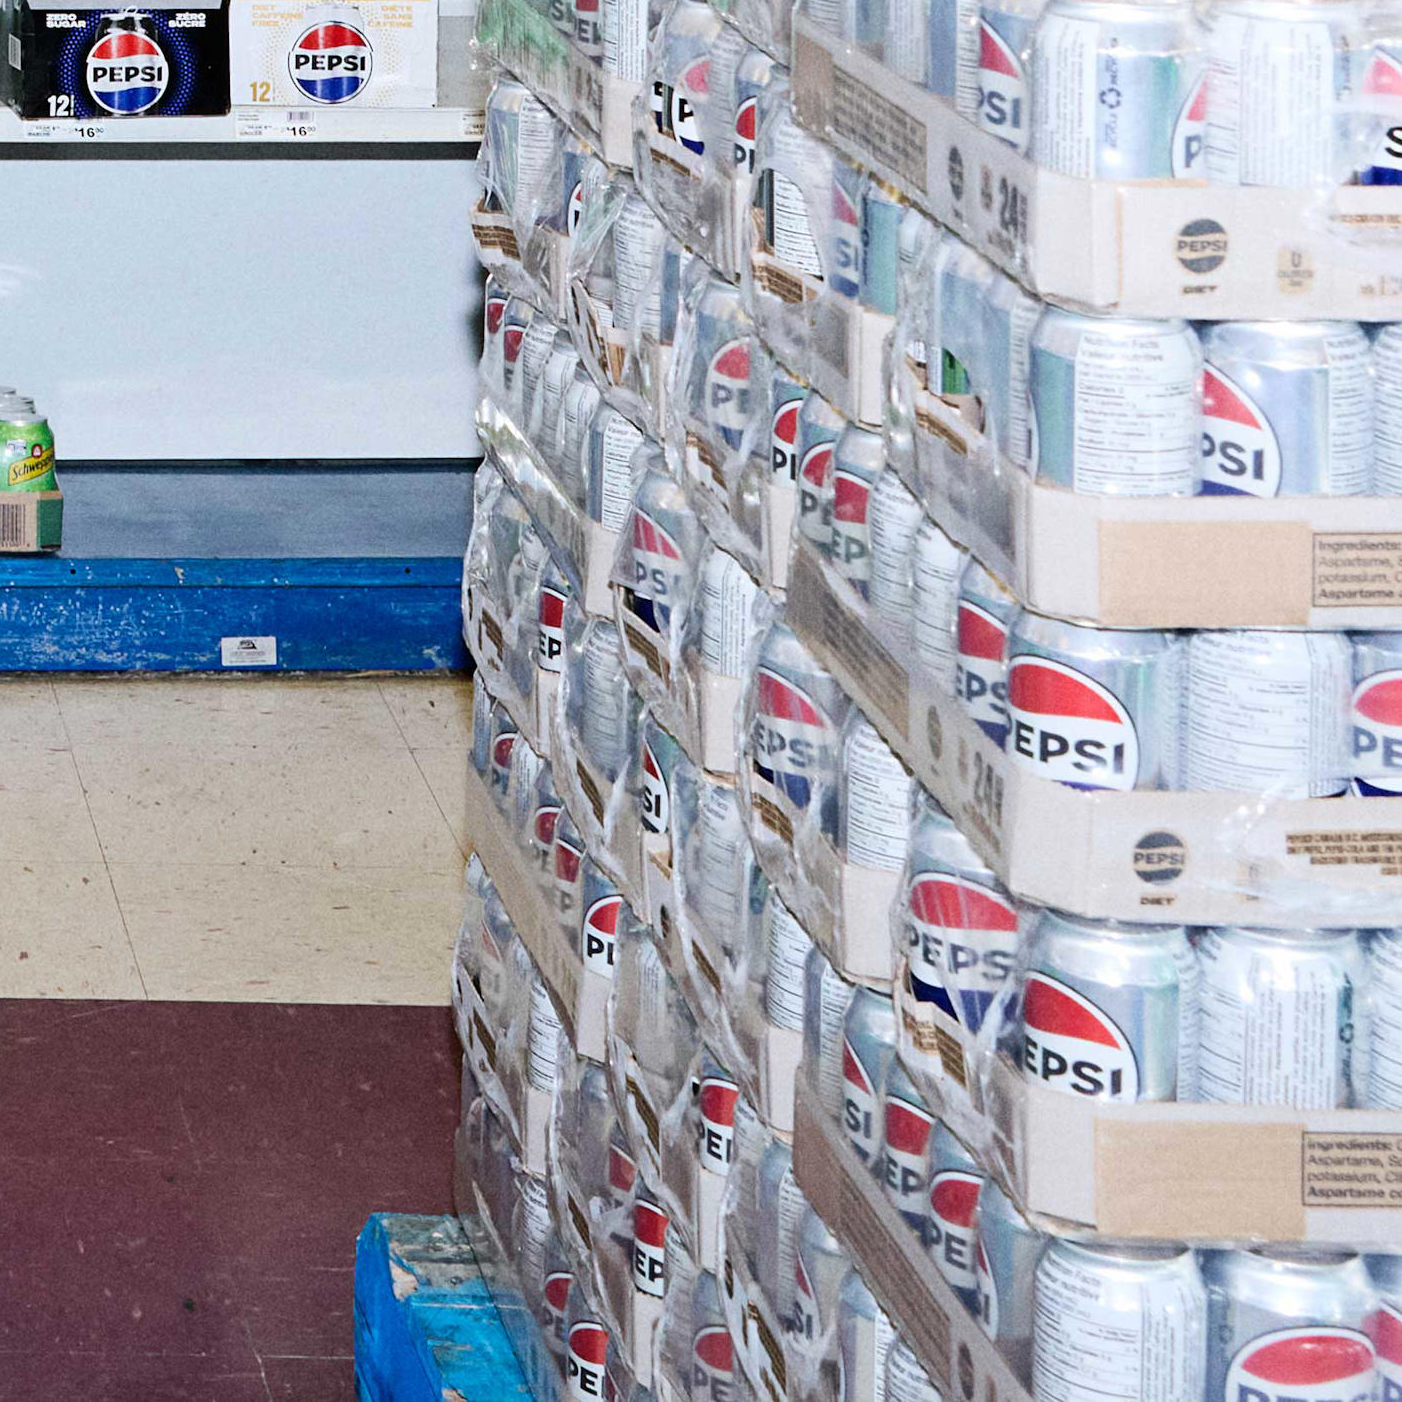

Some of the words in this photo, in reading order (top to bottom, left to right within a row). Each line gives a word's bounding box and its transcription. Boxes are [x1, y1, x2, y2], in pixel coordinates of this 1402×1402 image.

[46, 13, 77, 22] ZERO
[169, 20, 206, 29] SUCRE
[294, 54, 366, 71] PEPSI
[93, 65, 163, 83] PEPSI
[1177, 239, 1227, 252] PEPSI
[1133, 851, 1185, 865] PEPSI
